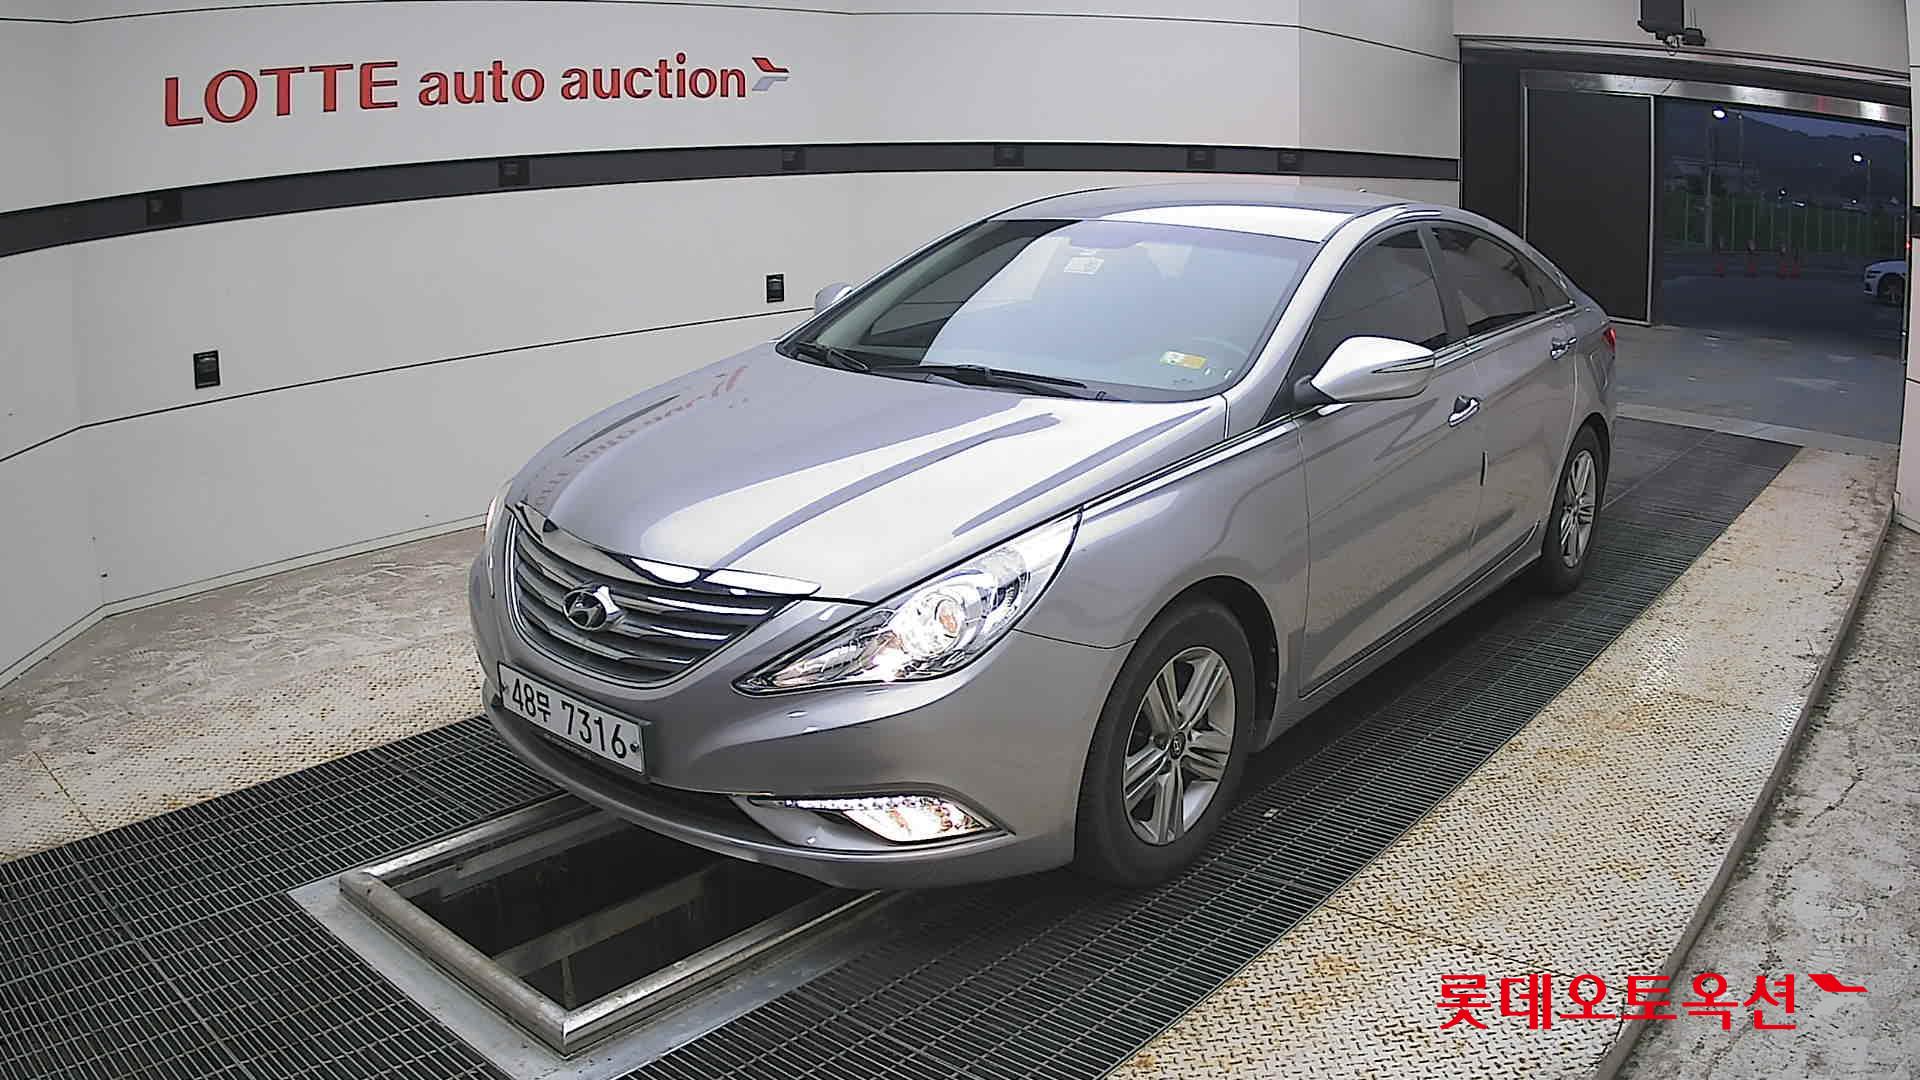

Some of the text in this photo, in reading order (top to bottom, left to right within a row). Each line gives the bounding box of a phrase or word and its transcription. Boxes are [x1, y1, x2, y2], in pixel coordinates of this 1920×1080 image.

[163, 52, 747, 127] LOTTE auto auction
[511, 678, 627, 759] 48무 7316
